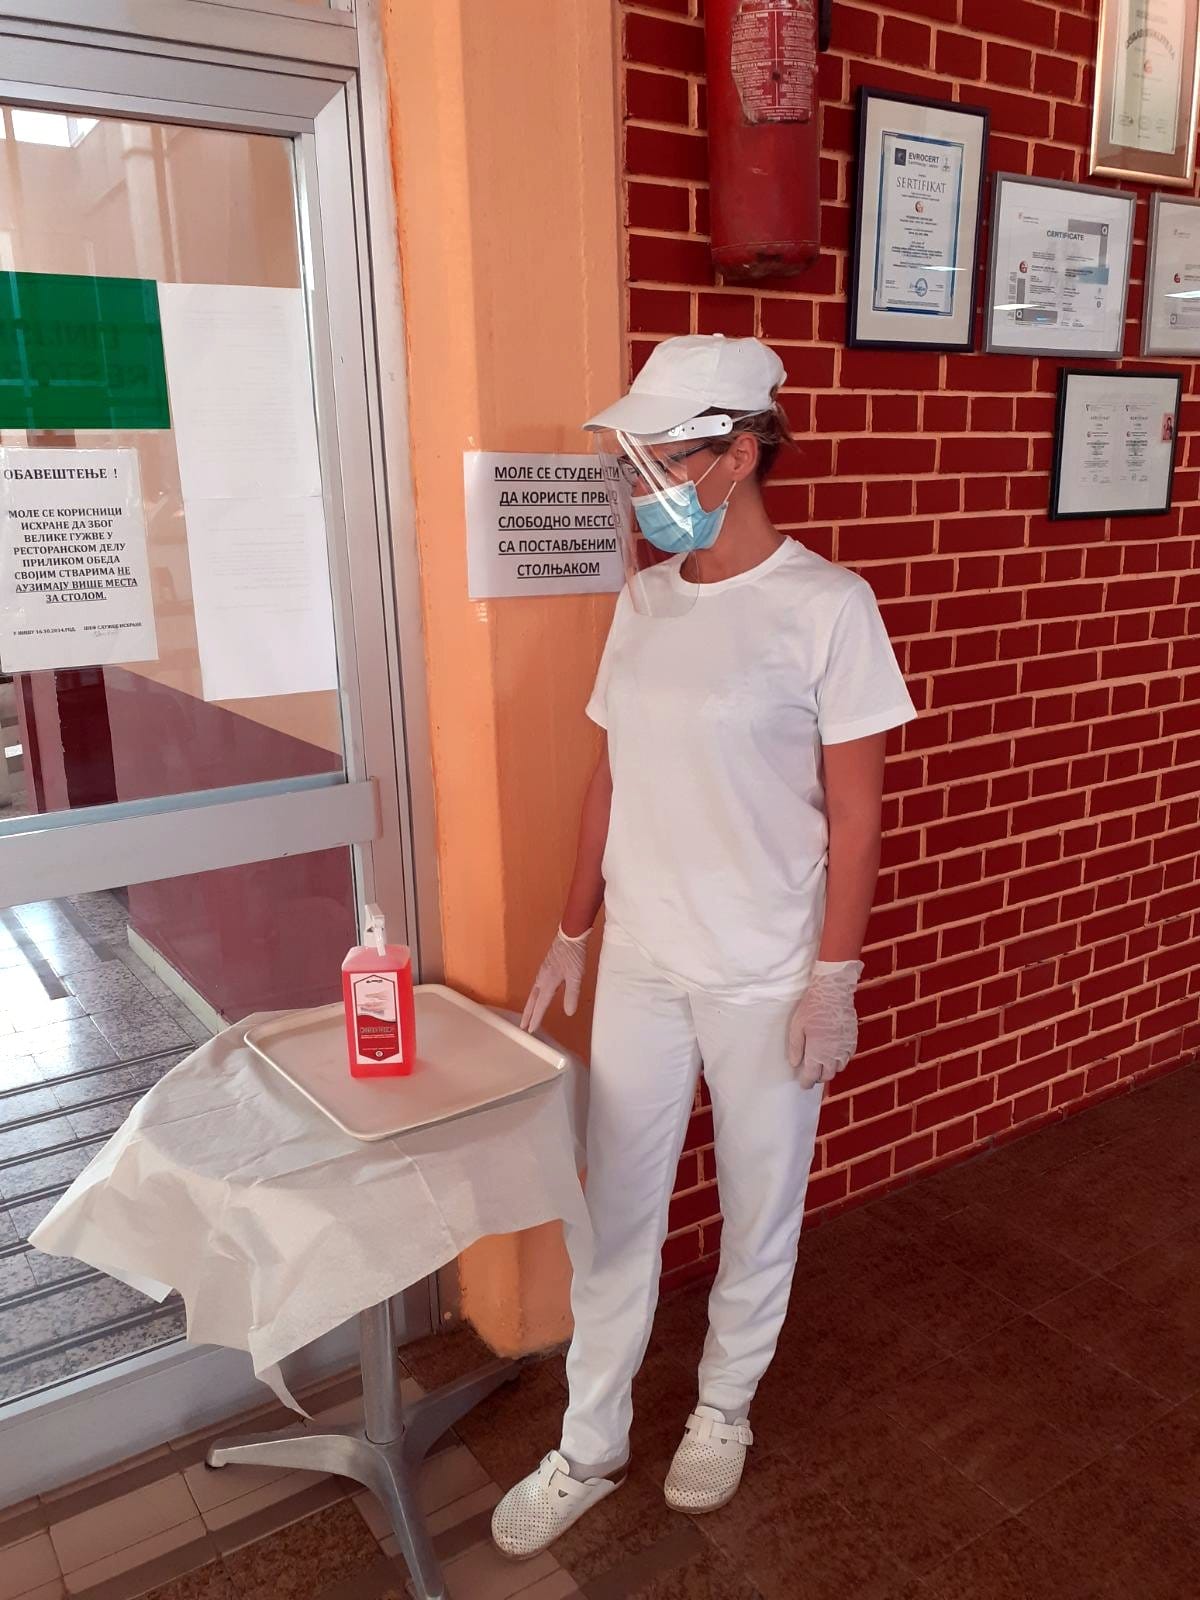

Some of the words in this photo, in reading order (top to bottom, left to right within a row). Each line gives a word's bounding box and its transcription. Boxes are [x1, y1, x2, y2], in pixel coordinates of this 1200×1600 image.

[908, 152, 939, 163] EVROCERT
[897, 176, 946, 193] SERTIFIKAT
[1046, 230, 1085, 240] CERTIFICATE
[3, 468, 108, 480] ОБАВЕШТЕЊЕ
[113, 468, 118, 479] !
[494, 466, 533, 480] МОЛЕ
[537, 467, 550, 479] СЕ
[500, 491, 518, 506] ДА
[522, 491, 578, 504] КОРИСТЕ
[8, 509, 40, 519] МОЛЕ
[42, 509, 55, 518] СЕ
[57, 507, 122, 518] КОРИСНИЦИ
[21, 521, 70, 531] ИСХРАНЕ
[71, 521, 86, 530] ДА
[88, 519, 114, 529] ЗБОГ
[498, 515, 571, 530] СЛОБОДНО
[574, 515, 617, 528] МЕСТО
[24, 533, 67, 543] ВЕЛИКЕ
[69, 532, 105, 541] ГУЖВЕ
[106, 531, 113, 540] У
[13, 544, 97, 555] РЕСТОРАНСКОМ
[99, 543, 126, 553] ДЕЛУ
[498, 540, 515, 553] СА
[519, 538, 617, 553] ПОСТАВЉЕНИМ
[22, 557, 84, 567] ПРИЛИКОМ
[86, 555, 121, 564] ОБЕДА
[14, 570, 56, 580] СВОЈИМ
[59, 567, 115, 578] СТВАРИМА
[117, 567, 131, 576] НЕ
[517, 562, 601, 577] СТОЛЊАКОМ
[72, 580, 104, 590] ВИШЕ
[105, 578, 138, 588] МЕСТА
[46, 594, 59, 603] ЗА
[61, 591, 107, 602] СТОЛОМ.
